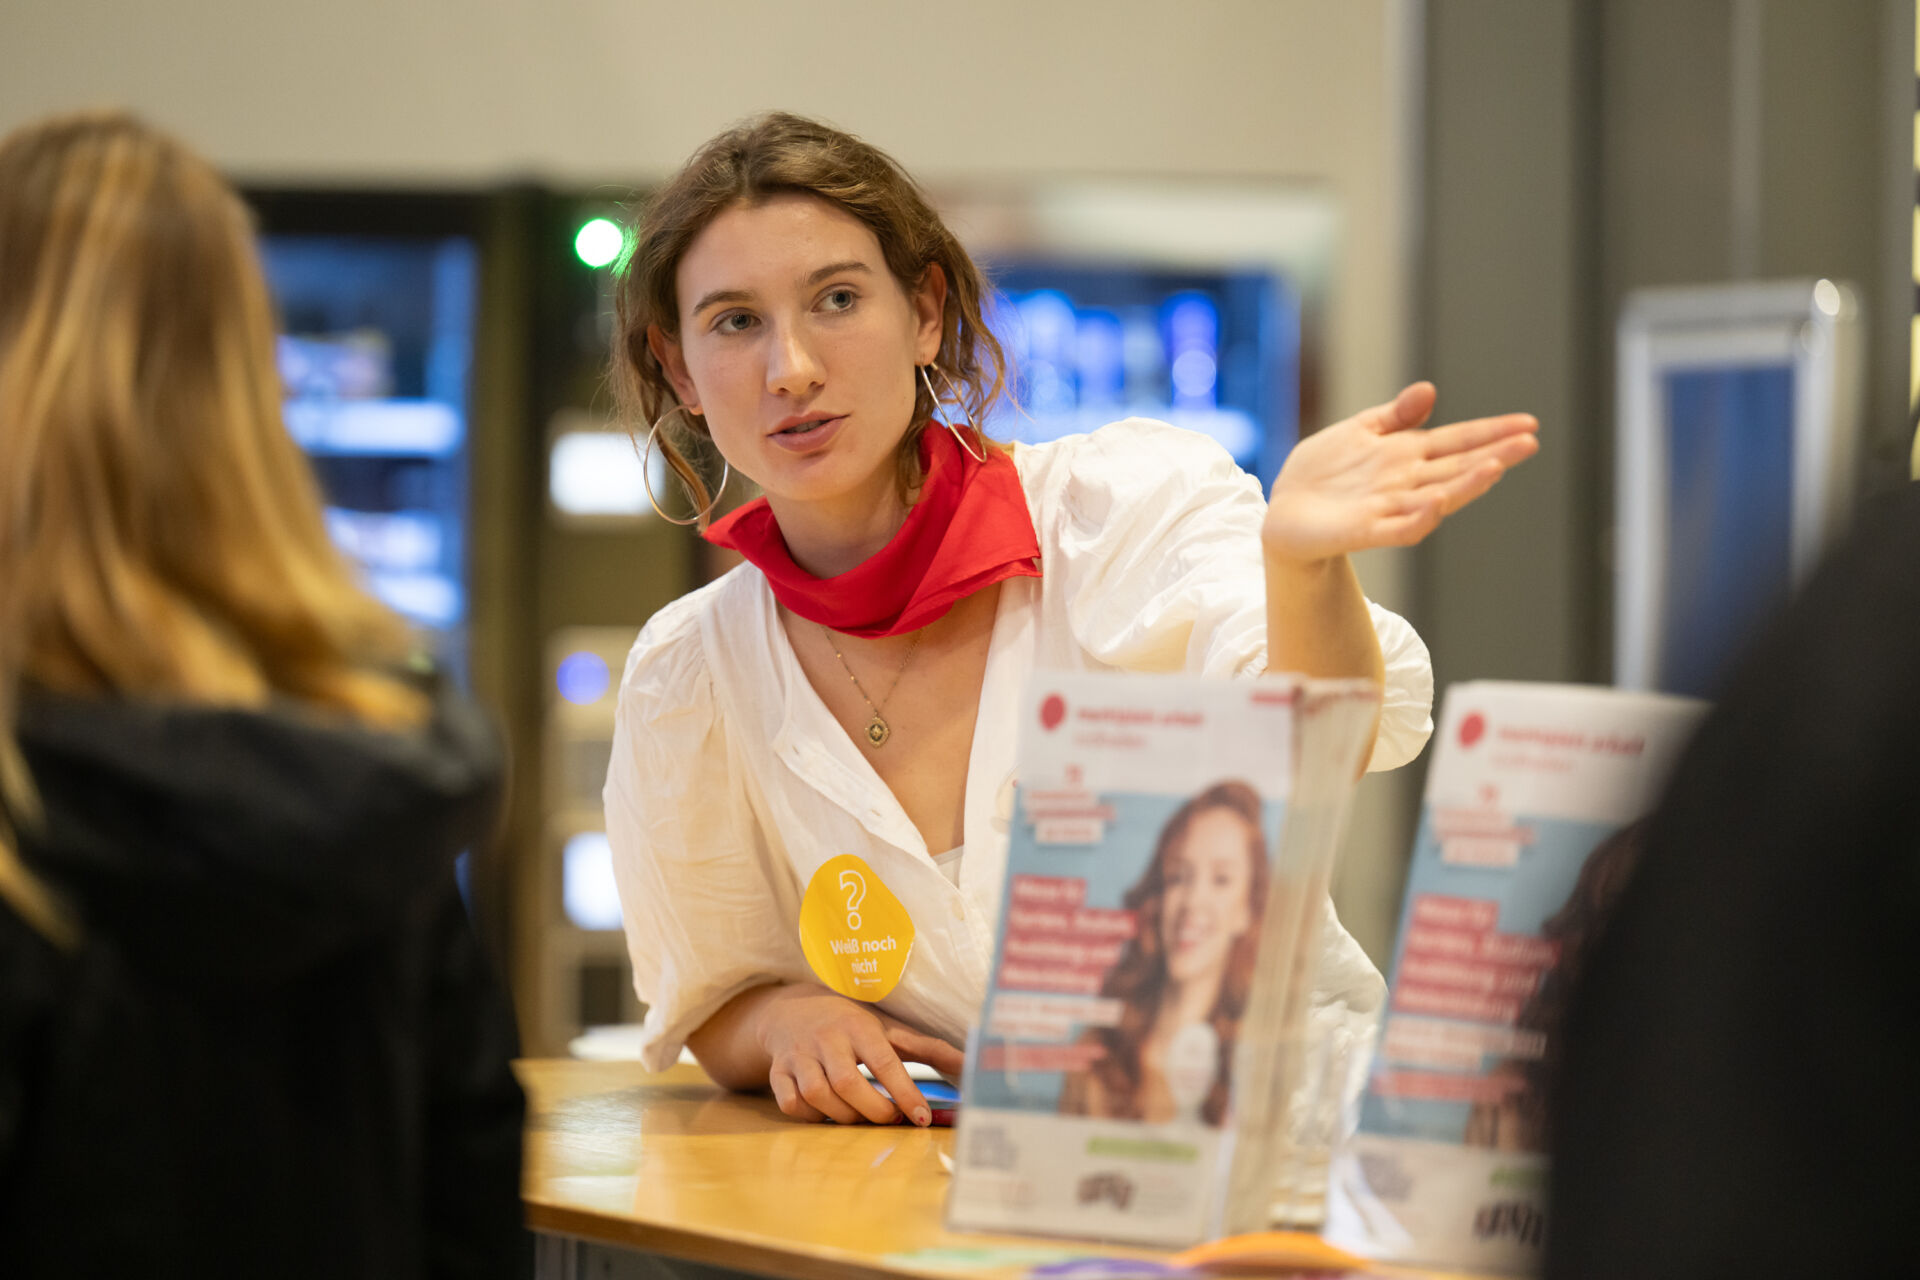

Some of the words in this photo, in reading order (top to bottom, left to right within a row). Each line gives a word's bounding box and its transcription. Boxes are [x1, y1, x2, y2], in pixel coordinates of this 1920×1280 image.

[830, 939, 859, 955] Weiß
[862, 936, 896, 951] noch
[852, 959, 878, 973] nicht
